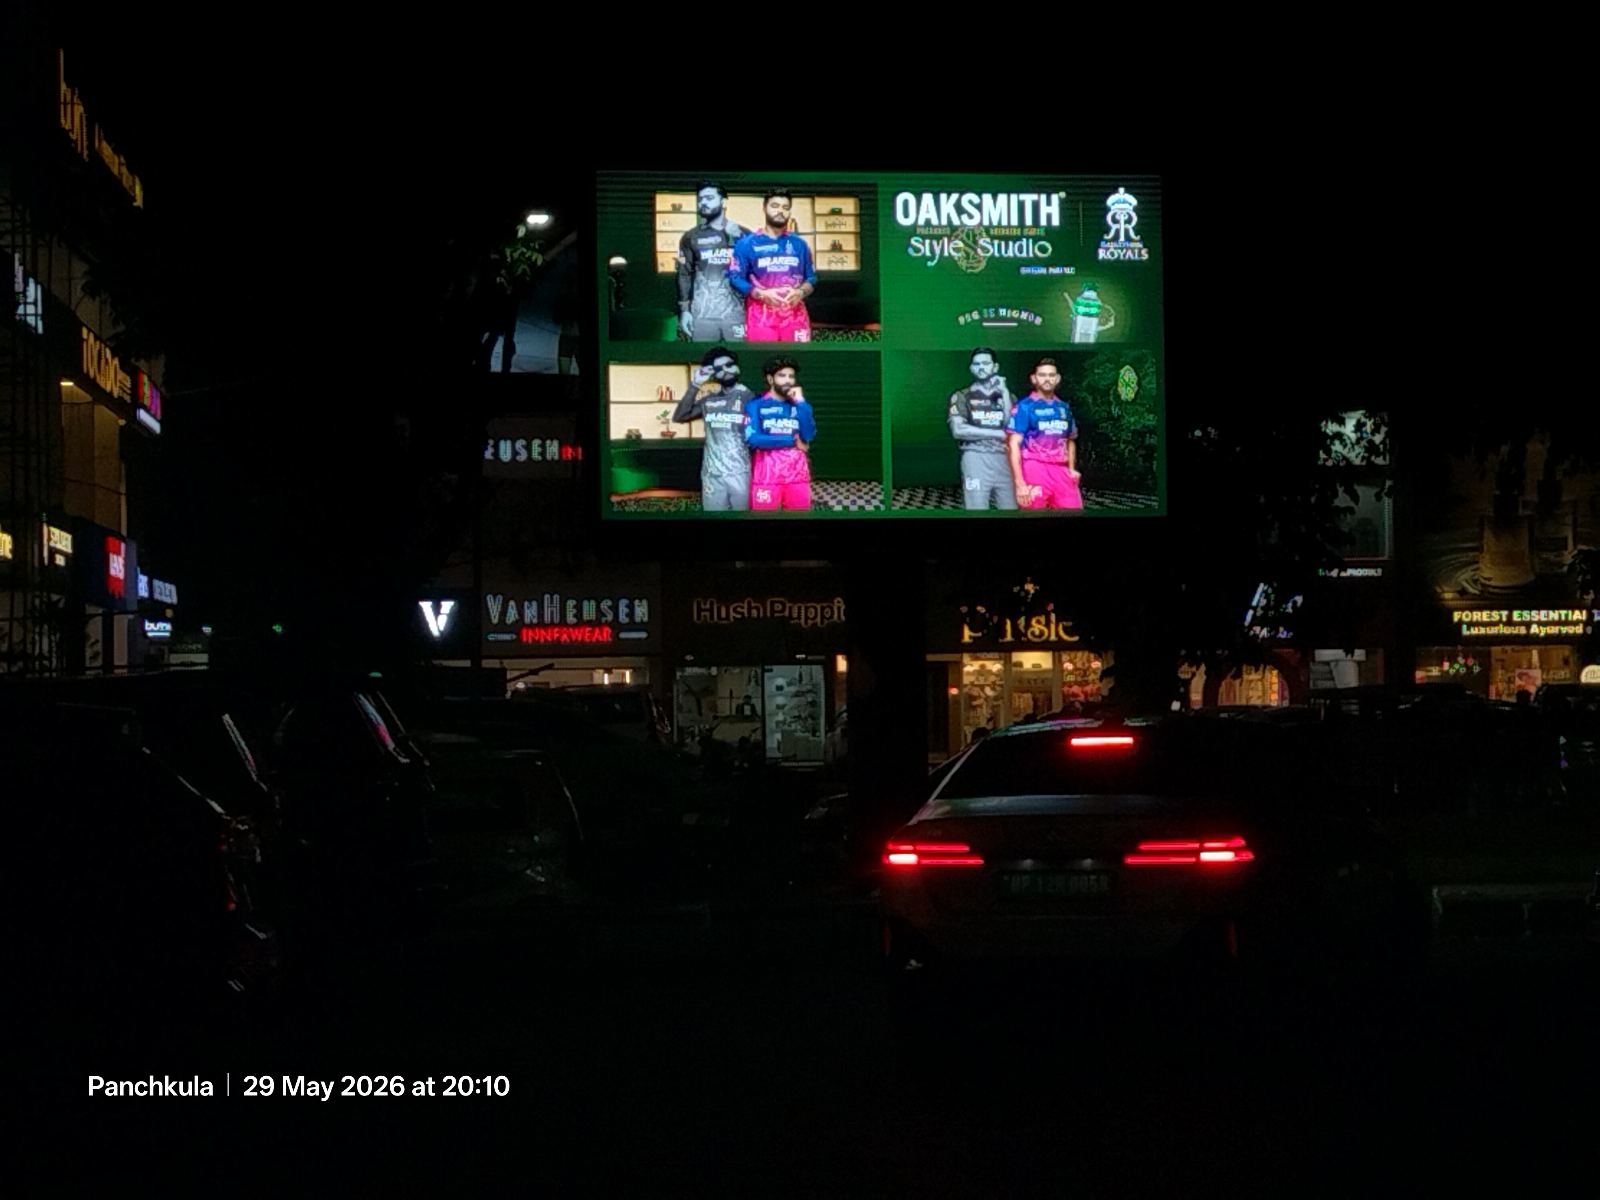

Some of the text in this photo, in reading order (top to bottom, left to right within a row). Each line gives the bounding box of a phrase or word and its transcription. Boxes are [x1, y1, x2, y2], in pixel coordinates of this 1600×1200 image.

[895, 191, 1060, 226] OAKSMITH
[907, 236, 1053, 267] Style Studio
[1098, 247, 1149, 260] ROYALS
[693, 598, 764, 624] Hush
[1453, 610, 1509, 622] FOREST
[1461, 623, 1527, 636] Luxurious
